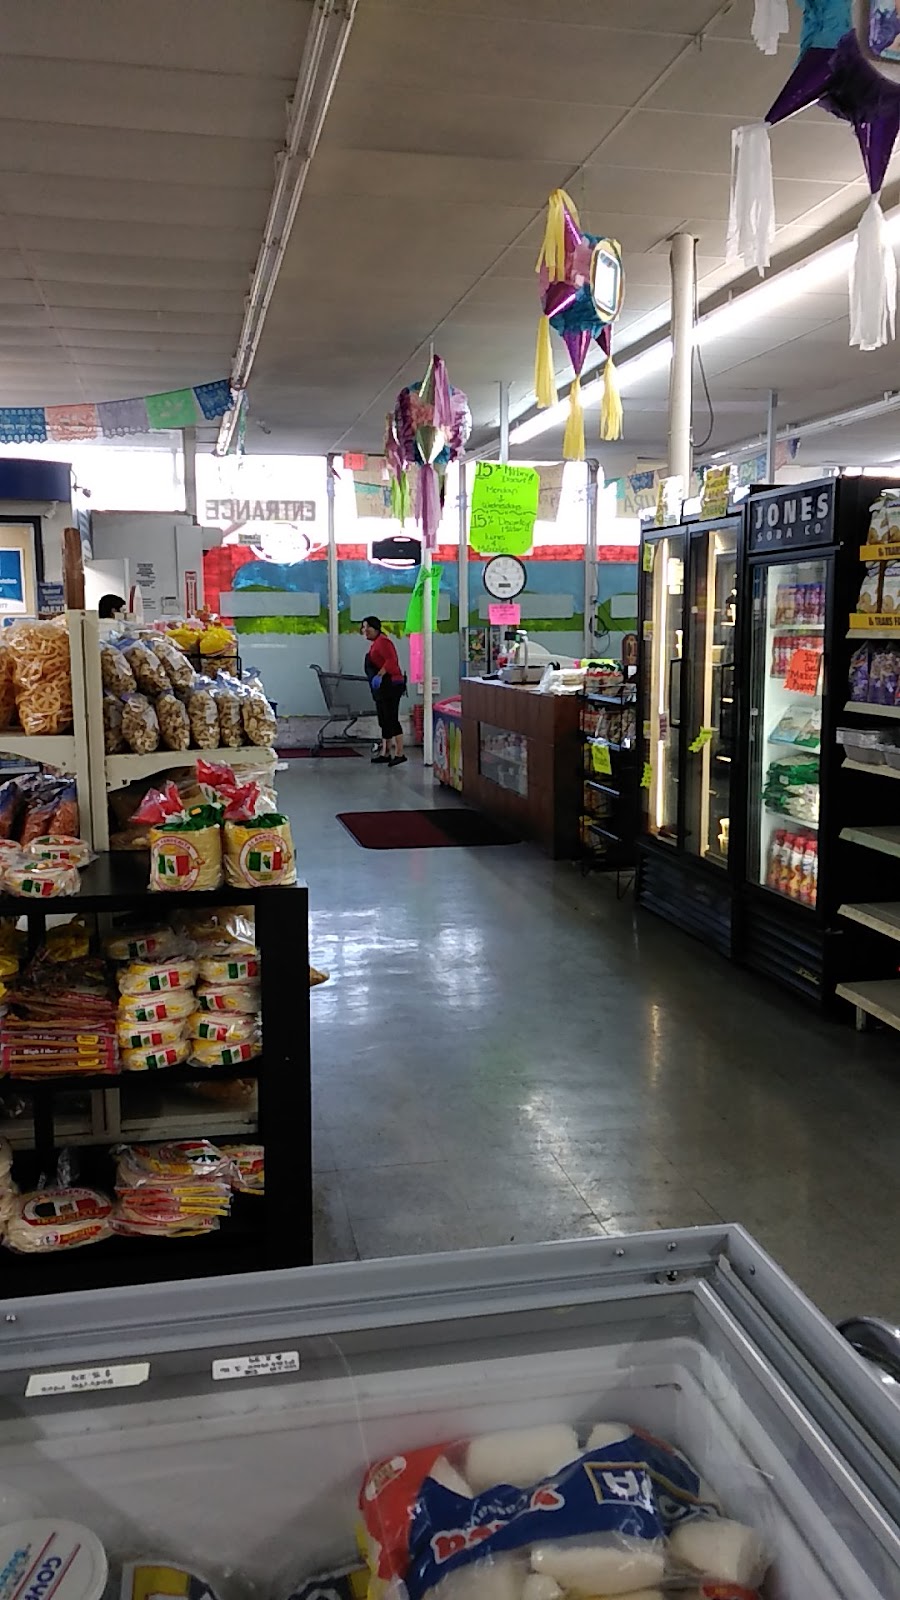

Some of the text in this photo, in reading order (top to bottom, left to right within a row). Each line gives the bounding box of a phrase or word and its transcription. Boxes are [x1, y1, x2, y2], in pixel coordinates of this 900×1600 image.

[475, 461, 493, 477] 15
[755, 493, 829, 529] JONES
[472, 514, 488, 528] 15
[757, 528, 793, 543] SODA
